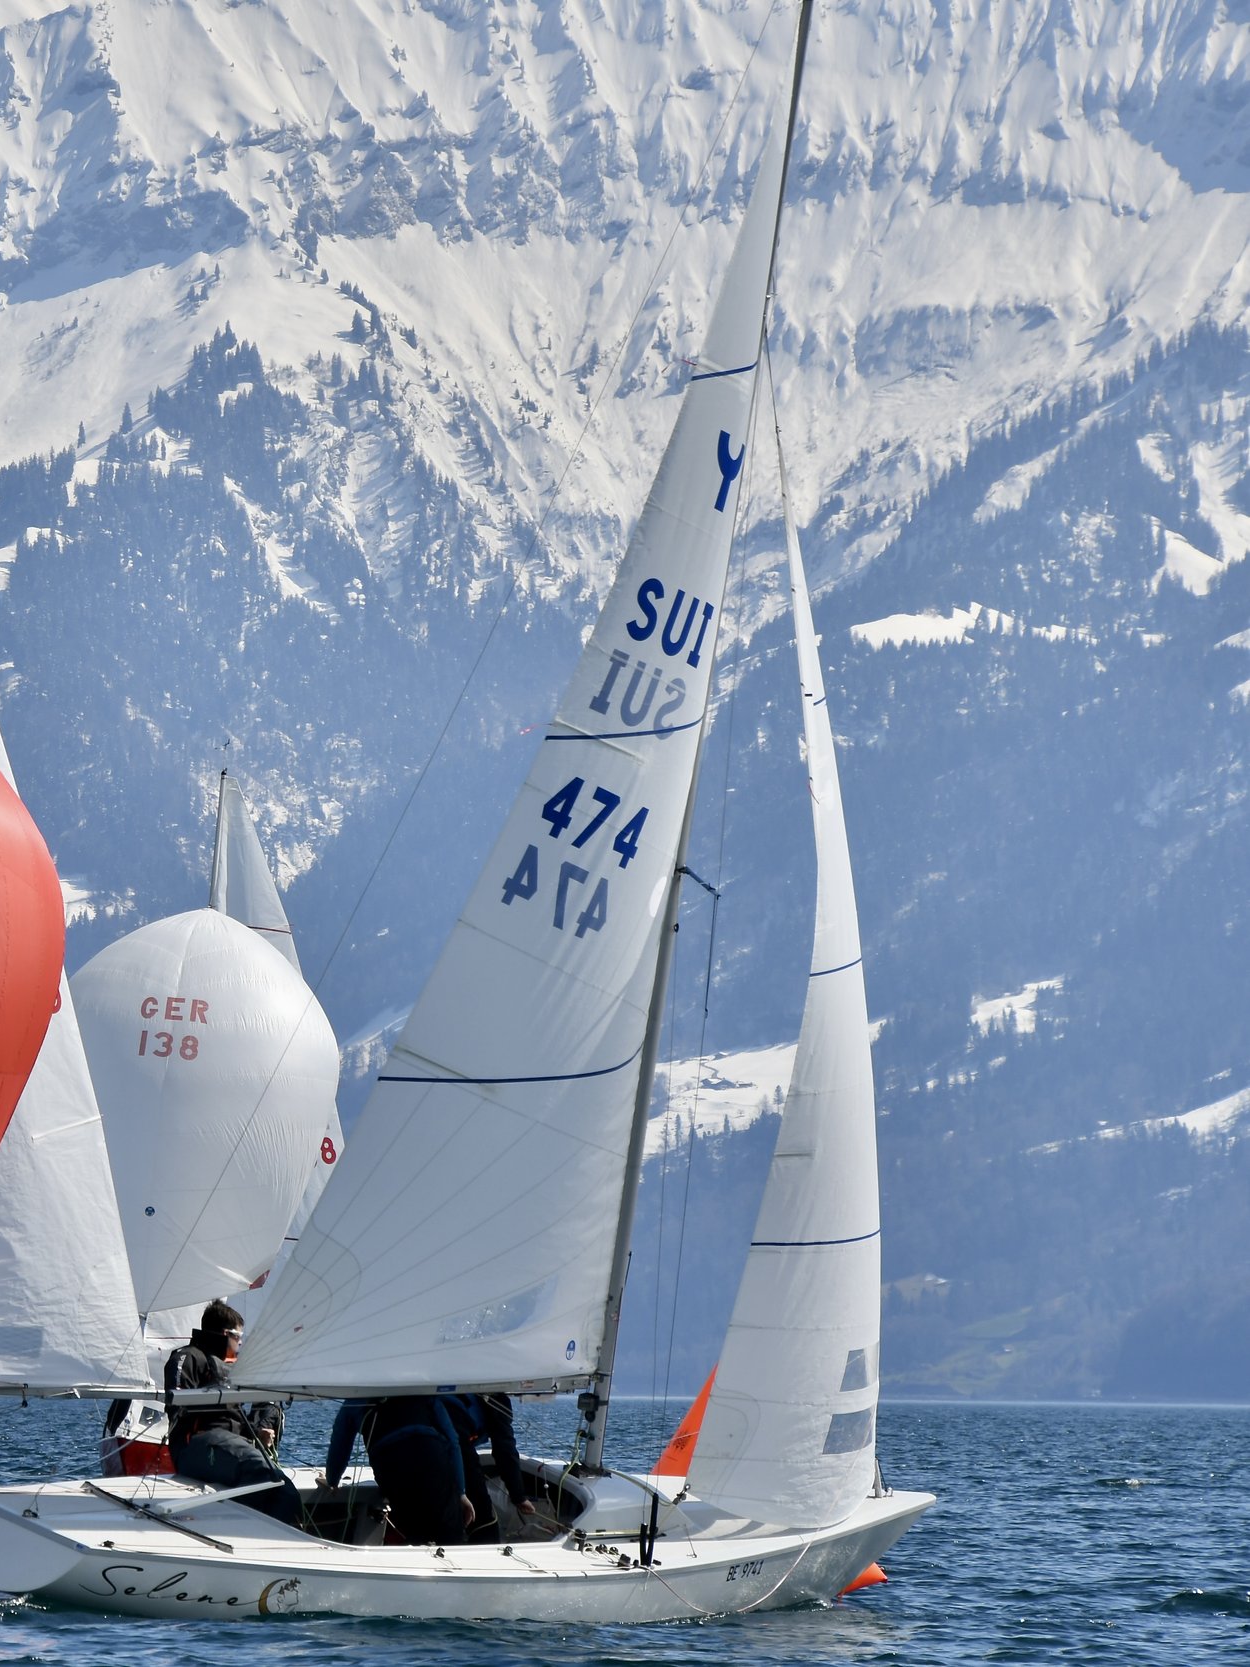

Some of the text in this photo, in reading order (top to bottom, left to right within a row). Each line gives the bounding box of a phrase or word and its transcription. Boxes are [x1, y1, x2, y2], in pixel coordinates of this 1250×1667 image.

[626, 578, 714, 669] SUI
[542, 776, 649, 869] 474
[140, 996, 209, 1025] GER
[138, 1030, 199, 1061] 138
[79, 1565, 260, 1607] Selene
[726, 1560, 764, 1581] BE 9741
